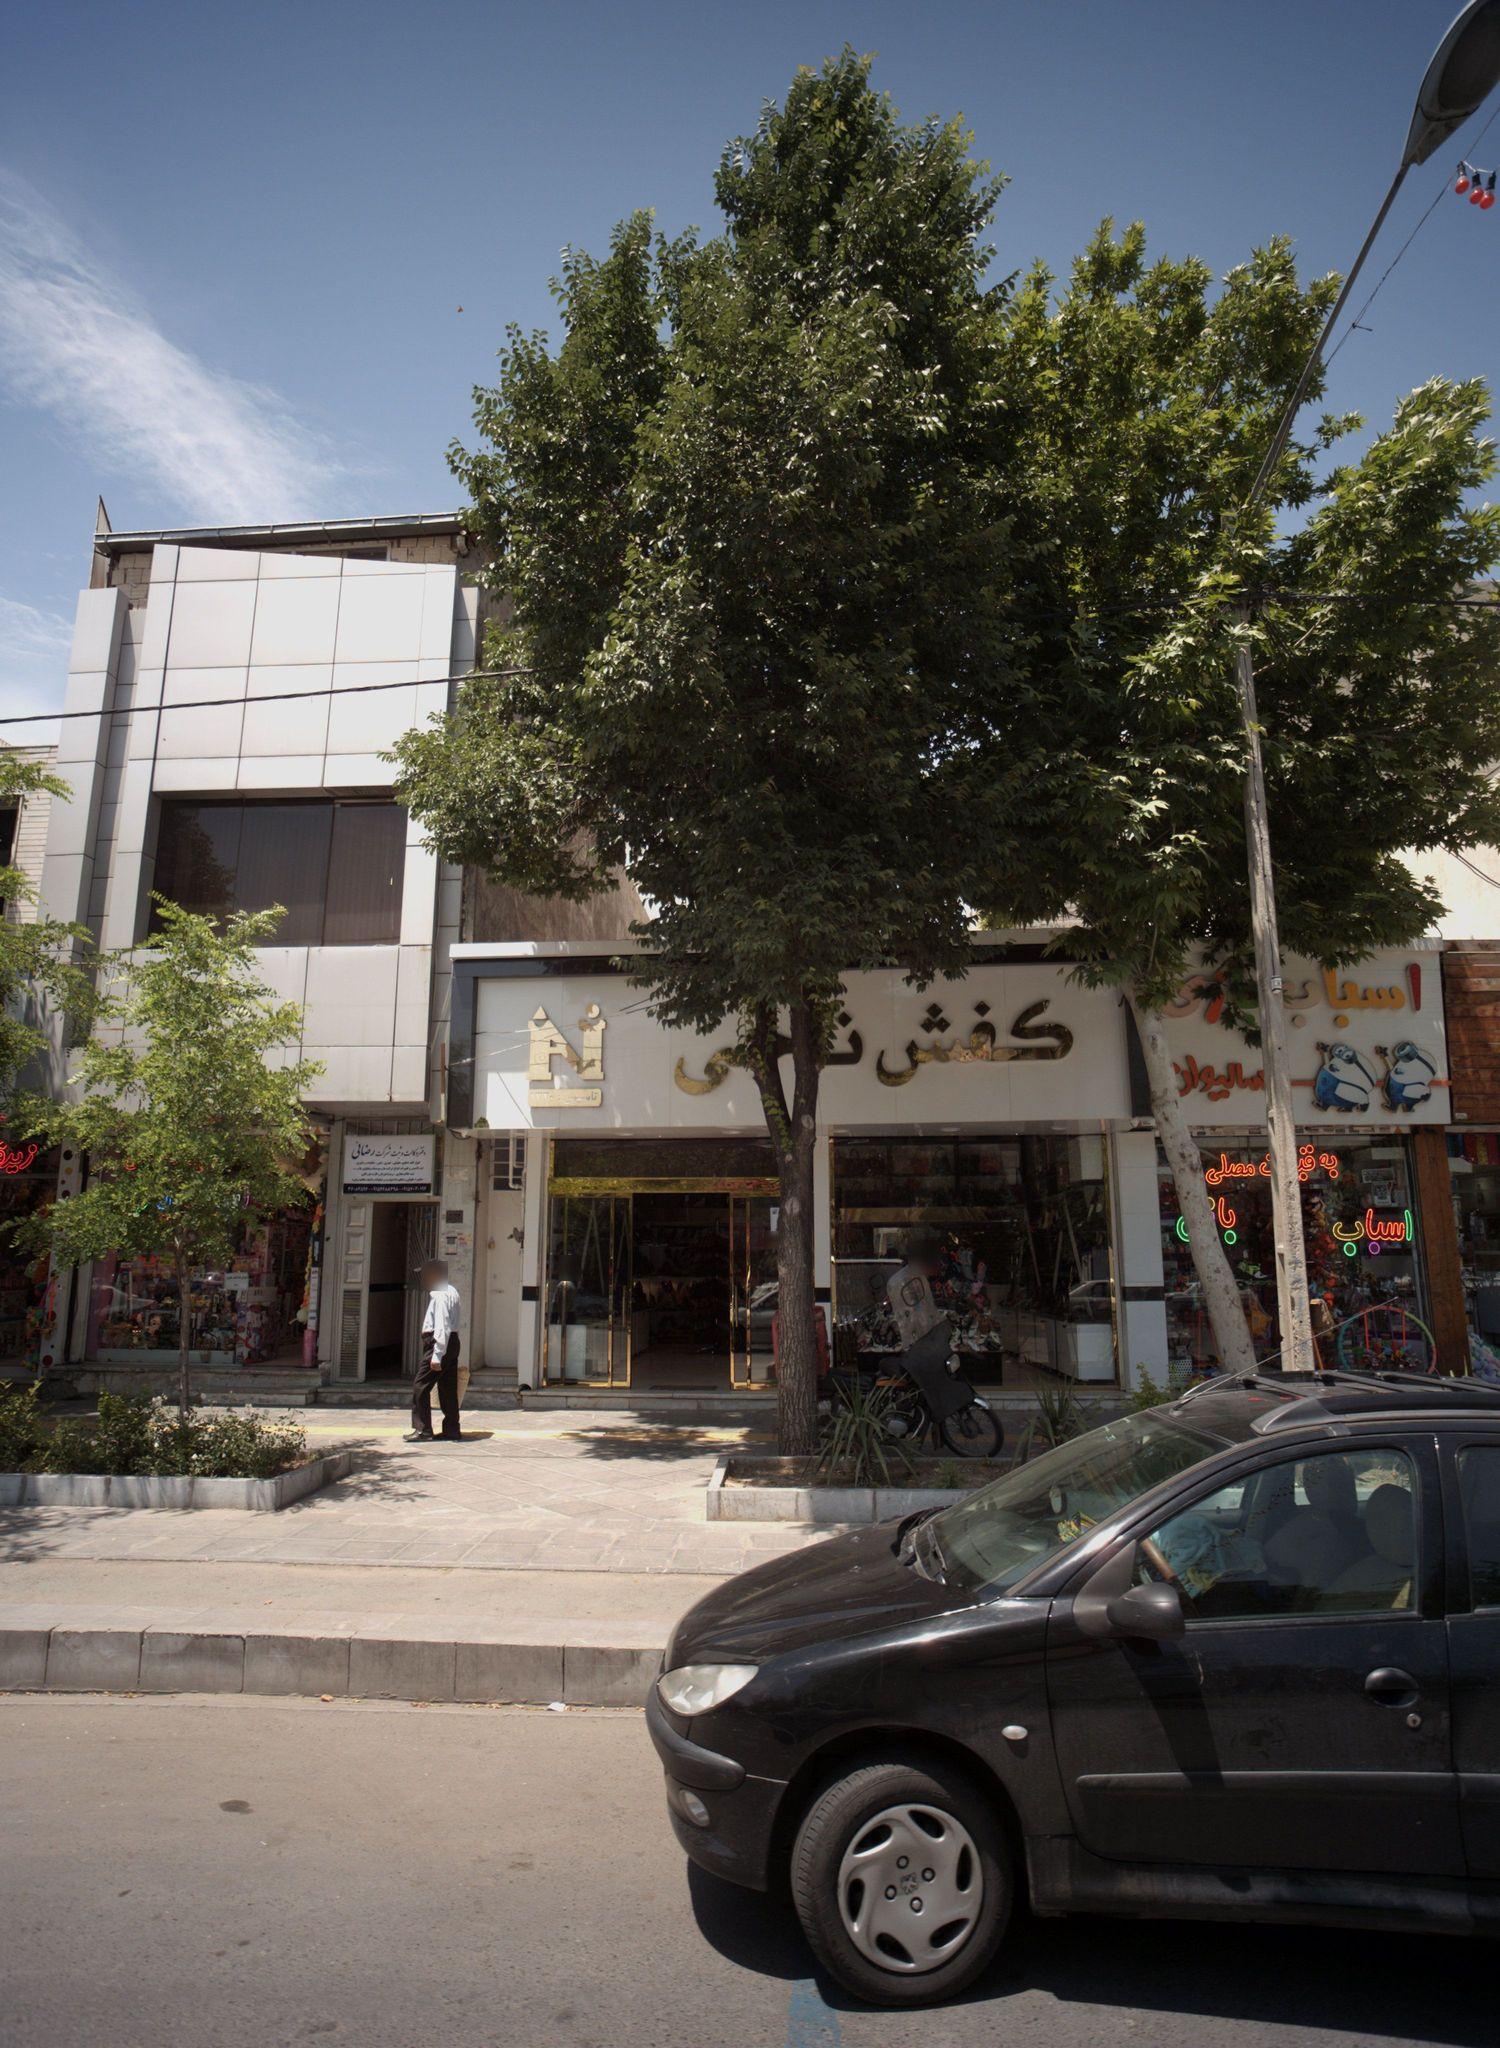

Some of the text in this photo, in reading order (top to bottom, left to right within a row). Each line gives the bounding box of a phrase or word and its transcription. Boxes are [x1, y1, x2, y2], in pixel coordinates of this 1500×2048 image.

[1280, 963, 1422, 1029] اسباب
[876, 999, 1074, 1087] کفش
[1205, 1153, 1256, 1184] مصلی
[1319, 1153, 1339, 1179] به
[1332, 1208, 1413, 1257] اسباب
